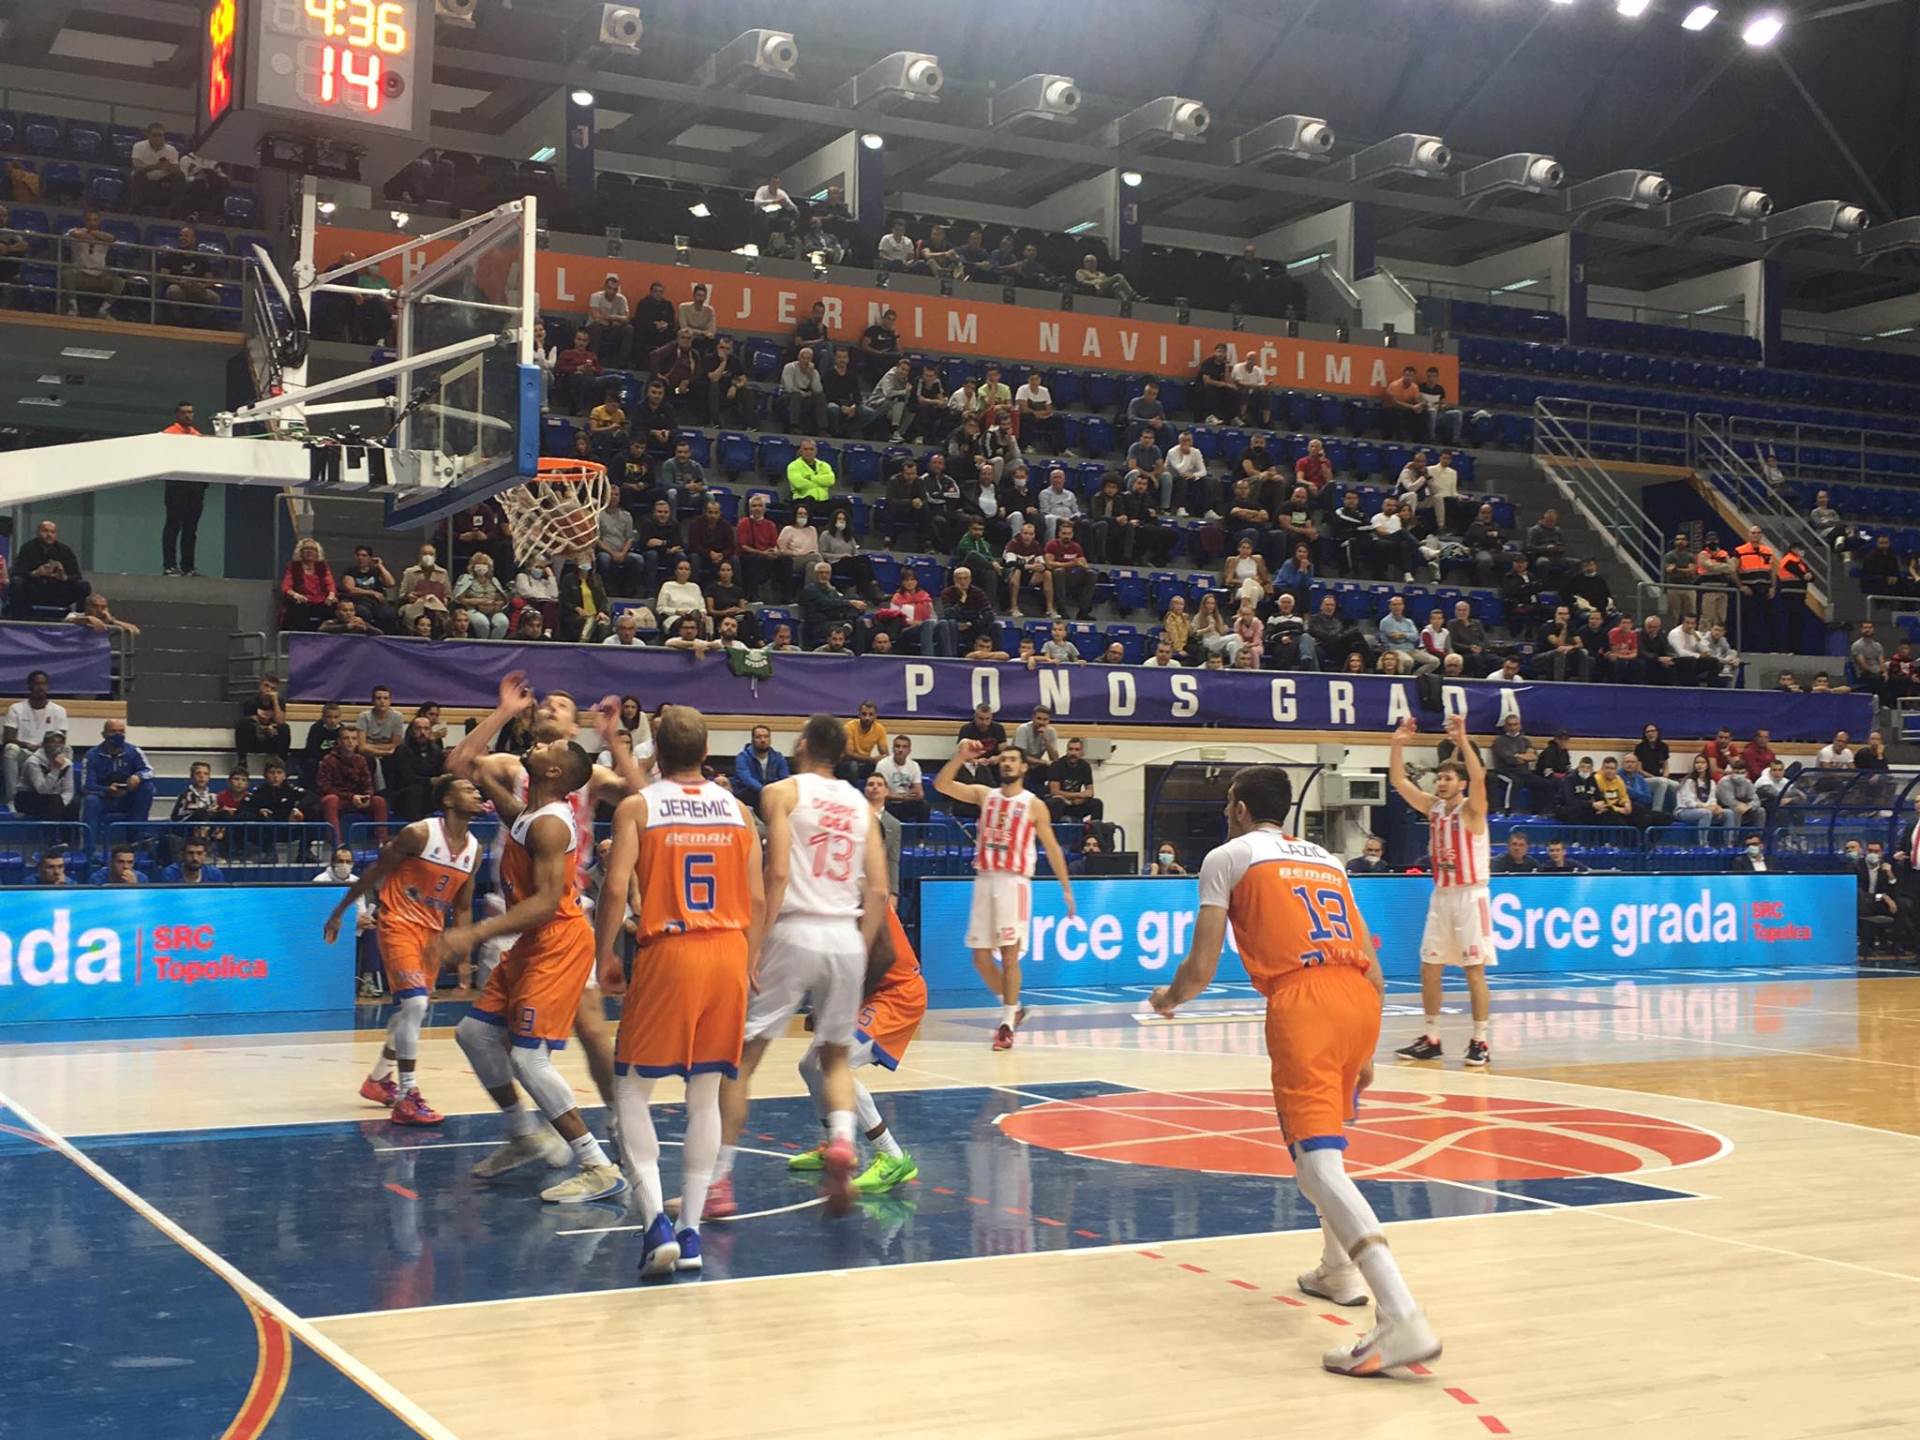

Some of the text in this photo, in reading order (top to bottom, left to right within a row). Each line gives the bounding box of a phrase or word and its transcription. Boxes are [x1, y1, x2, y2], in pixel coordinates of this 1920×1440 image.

[304, 0, 407, 54] 4:36
[320, 45, 381, 111] 14
[905, 663, 1521, 727] PONOS GRADA
[660, 798, 732, 818] JEREMIĆ
[683, 852, 716, 912] 6
[808, 831, 855, 882] 13
[153, 924, 216, 951] SRC
[993, 911, 1123, 962] rce
[1291, 884, 1353, 943] 13
[1491, 888, 1737, 958] Srce grada
[153, 956, 268, 985] Topolica
